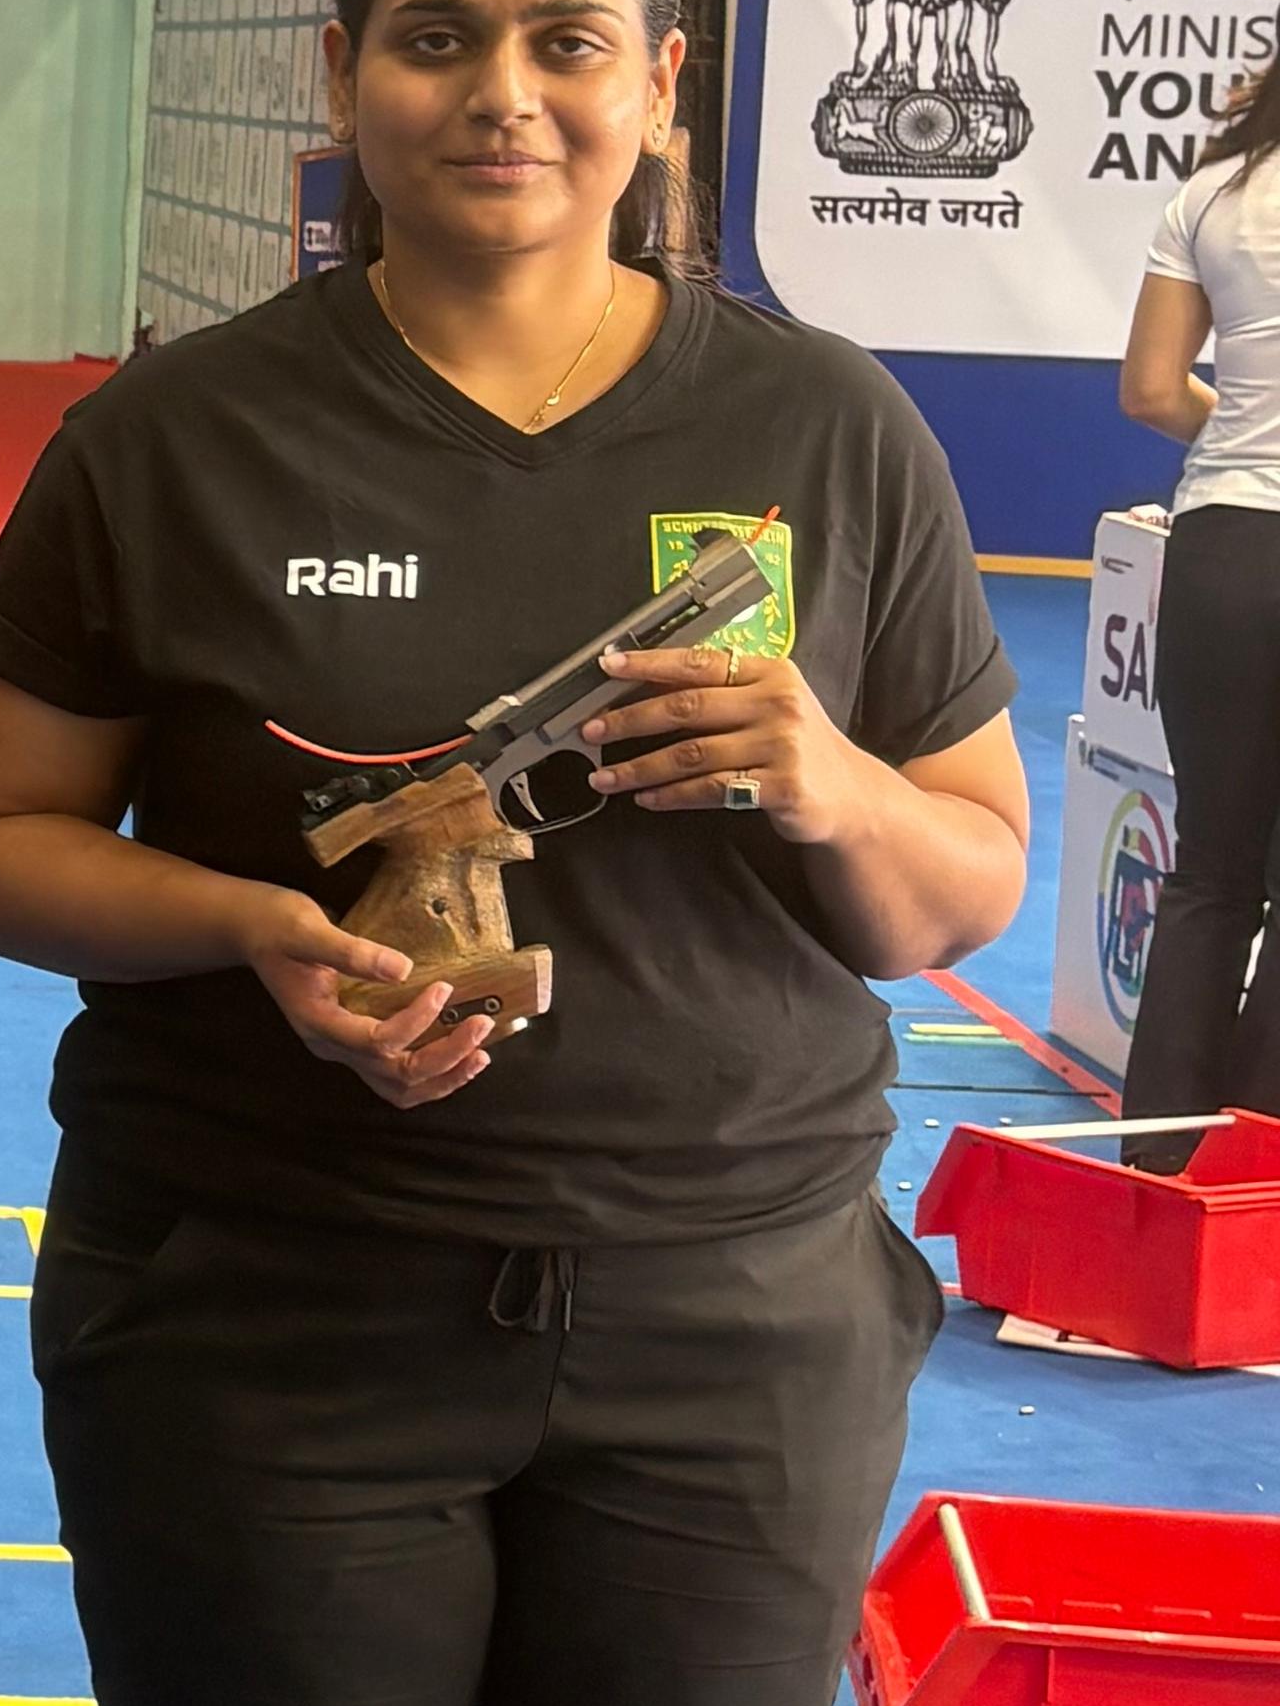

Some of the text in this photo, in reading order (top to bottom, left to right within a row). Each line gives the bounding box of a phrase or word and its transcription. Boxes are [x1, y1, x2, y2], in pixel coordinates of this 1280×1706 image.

[1100, 13, 1276, 60] MINIS
[808, 186, 1024, 229] सत्यमेव जयते
[286, 553, 419, 599] Rahi
